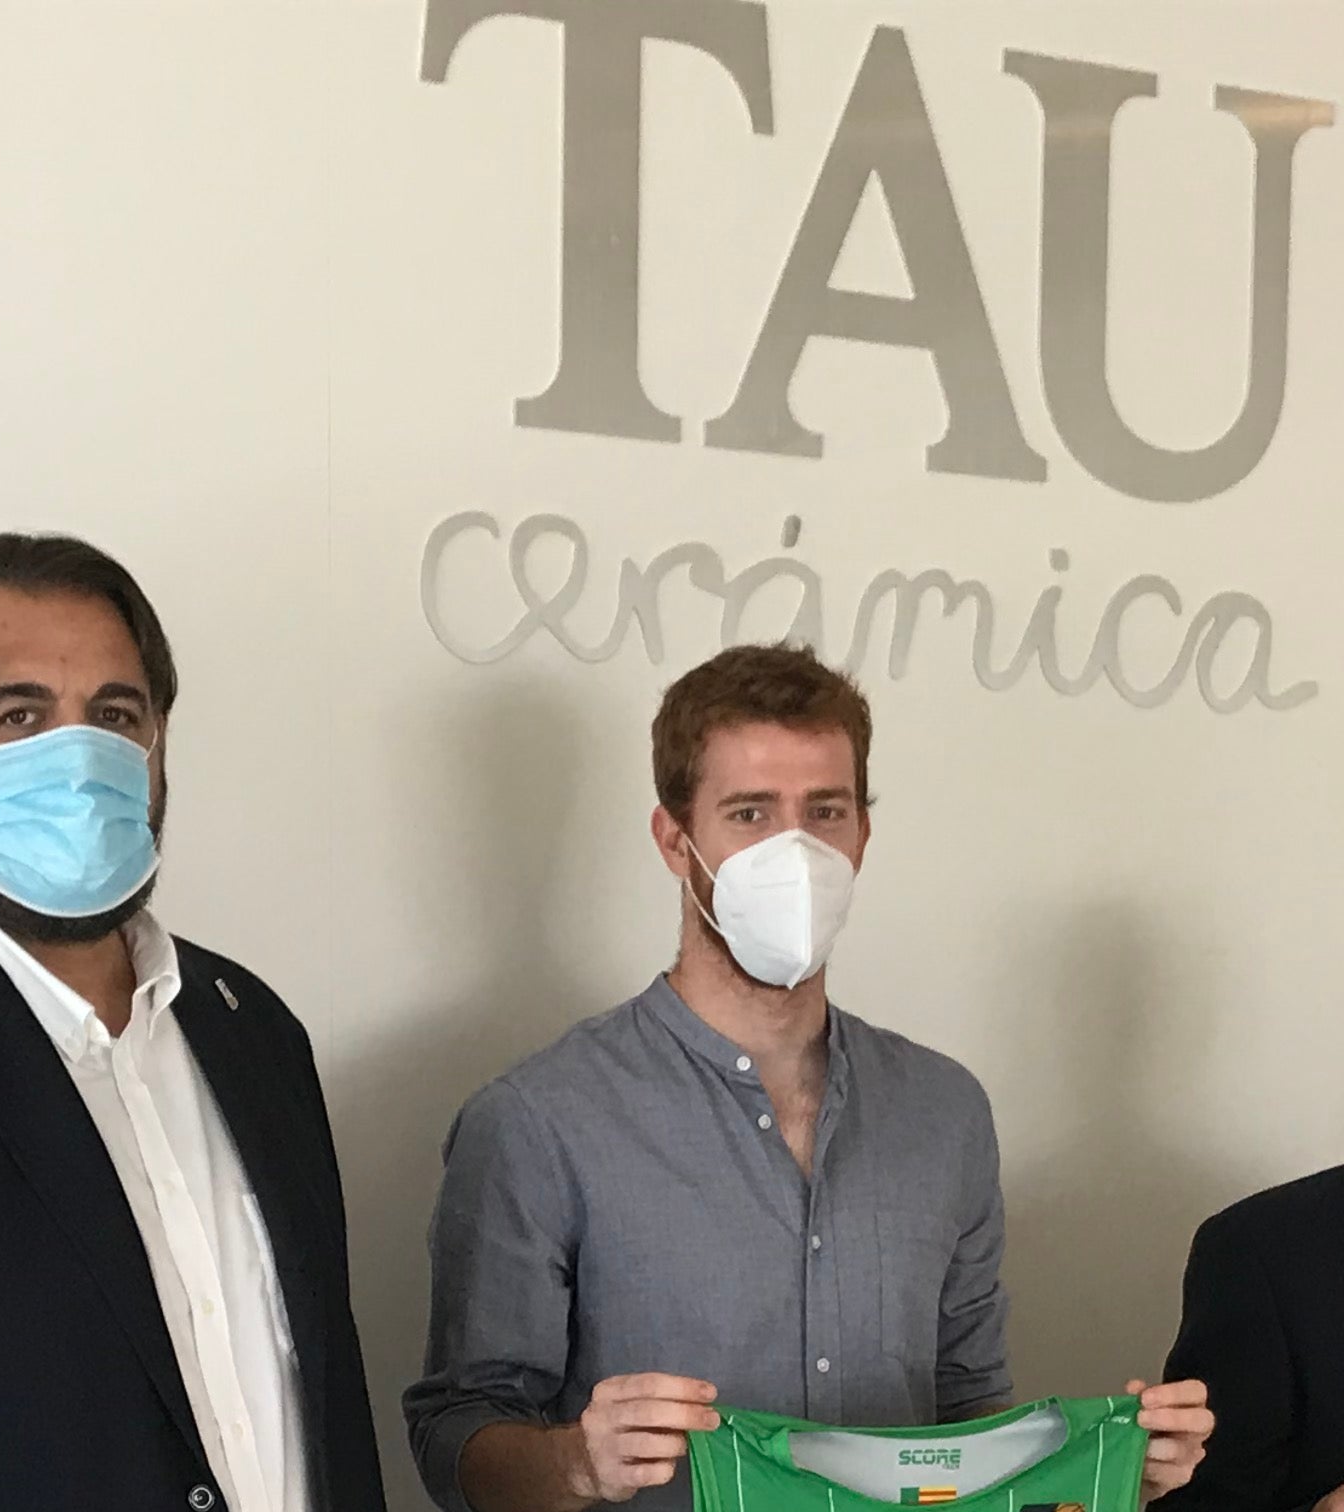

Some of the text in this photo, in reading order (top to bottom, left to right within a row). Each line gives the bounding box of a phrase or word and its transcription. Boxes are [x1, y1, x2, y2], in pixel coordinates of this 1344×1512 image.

[420, 0, 1335, 503] TAU
[420, 511, 1319, 714] cerámica
[898, 1448, 962, 1466] SCORE
